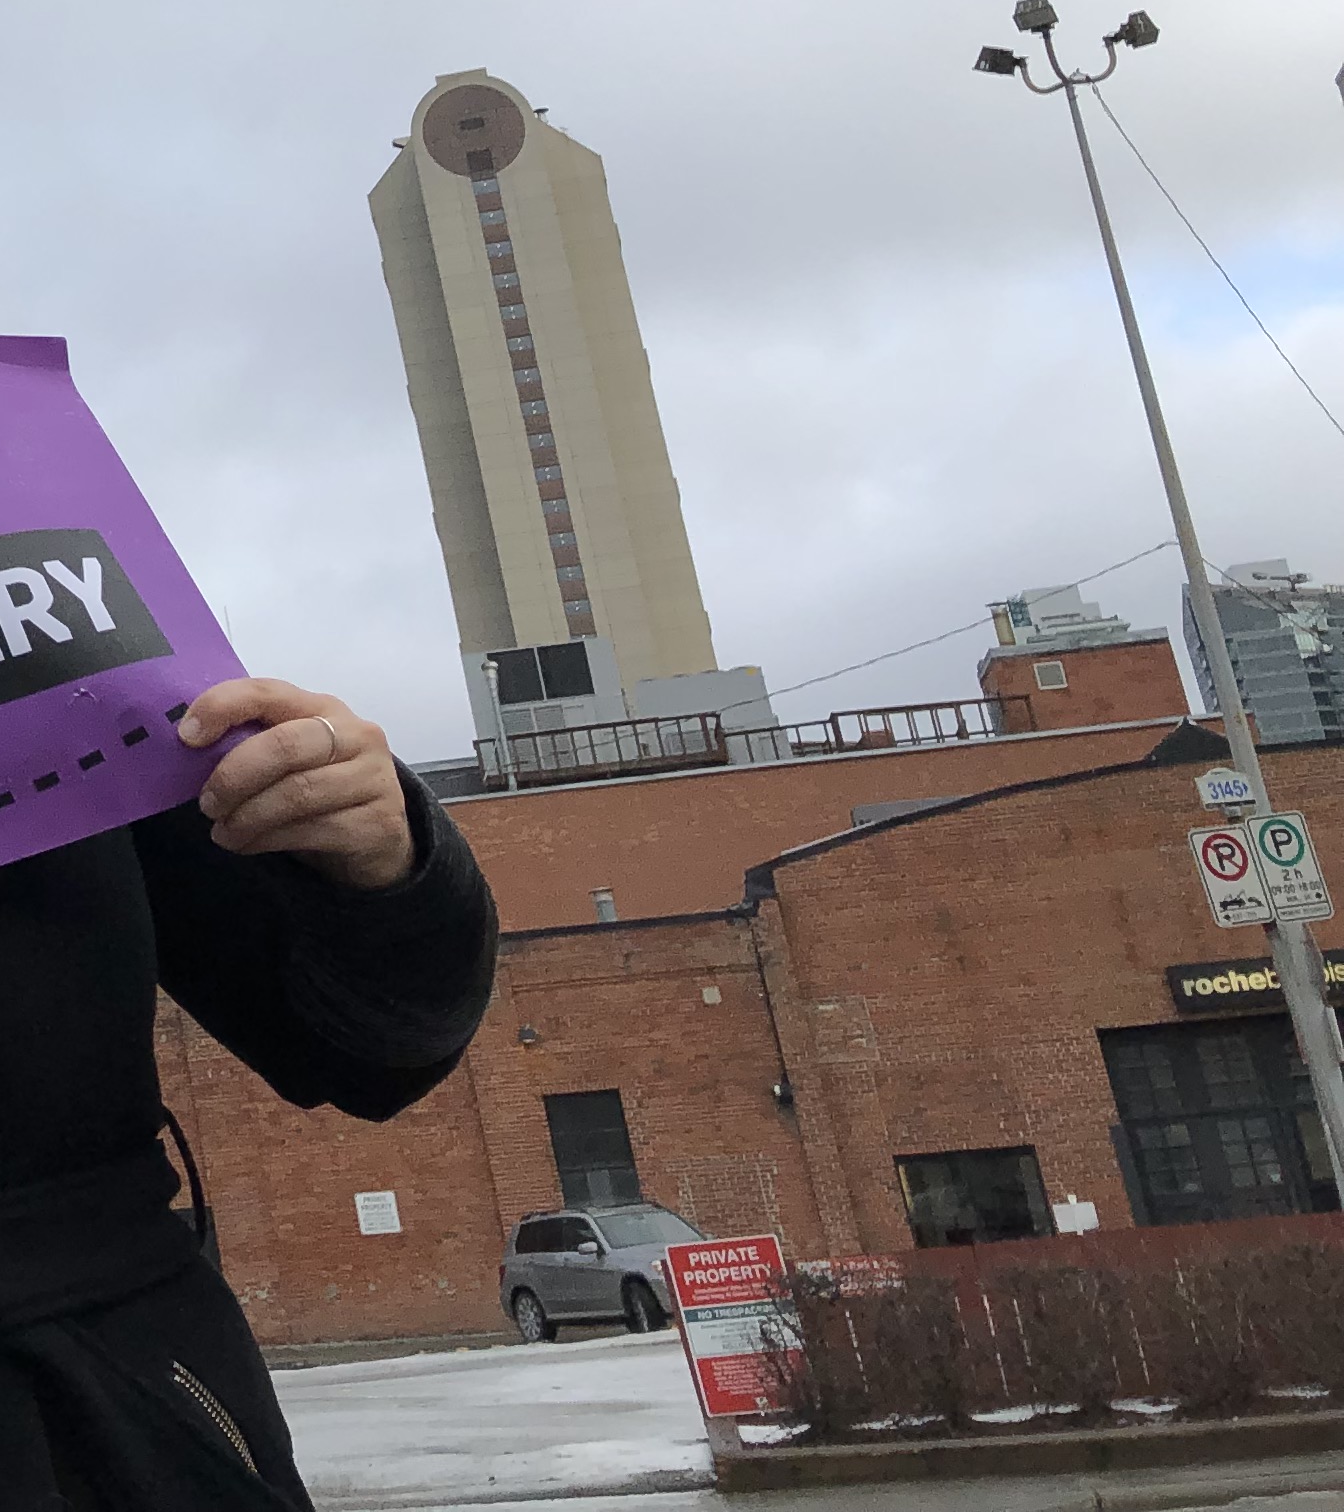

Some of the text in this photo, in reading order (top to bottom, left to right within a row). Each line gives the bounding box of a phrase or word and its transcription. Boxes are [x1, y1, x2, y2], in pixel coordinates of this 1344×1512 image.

[1207, 779, 1244, 800] 3145
[1269, 828, 1292, 857] P
[1281, 868, 1303, 881] 2 h
[688, 1245, 760, 1267] PRIVATE
[683, 1263, 771, 1286] PROPERTY
[697, 1308, 712, 1320] NO
